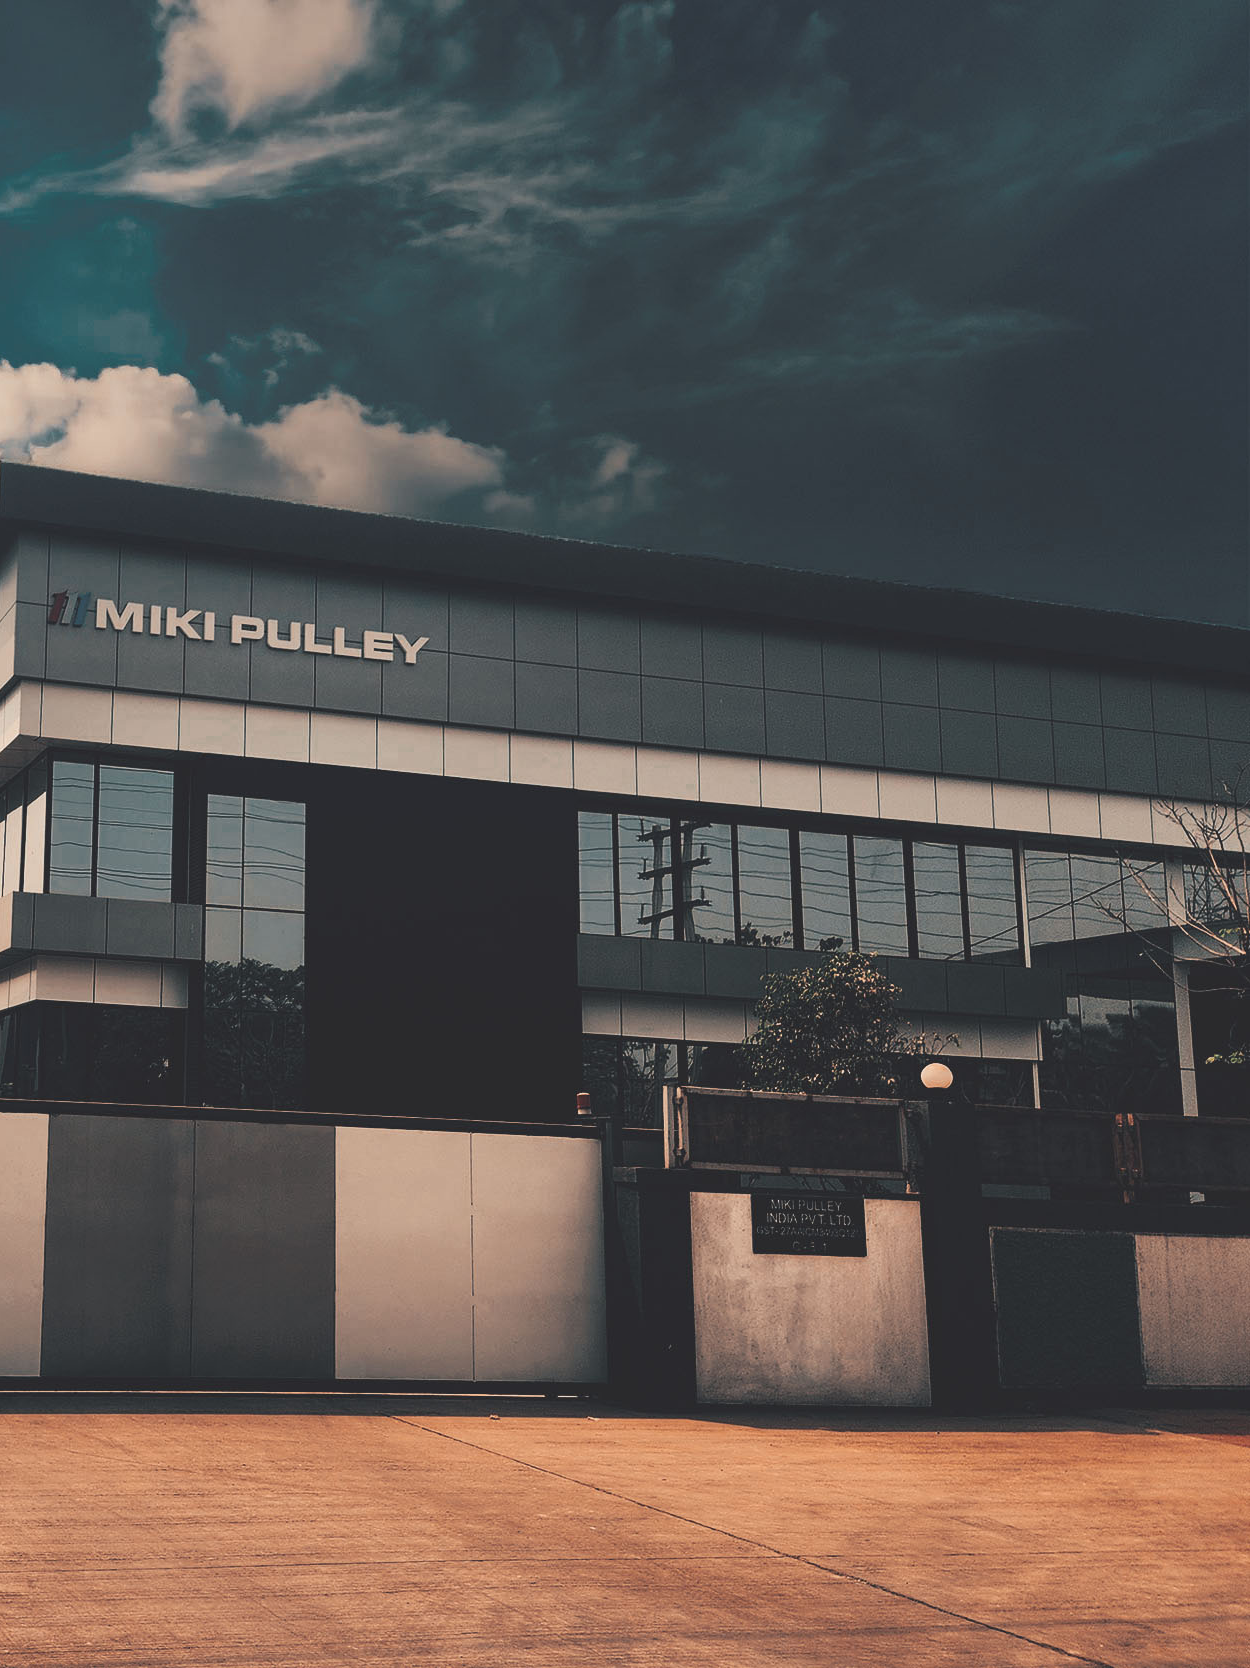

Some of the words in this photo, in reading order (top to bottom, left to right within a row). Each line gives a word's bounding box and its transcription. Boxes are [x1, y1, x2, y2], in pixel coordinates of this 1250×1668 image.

[95, 598, 215, 641] MIKI
[231, 614, 430, 664] PULLEY
[770, 1199, 795, 1210] MIKI
[798, 1199, 842, 1211] PULLEY
[766, 1212, 798, 1224] INDIA
